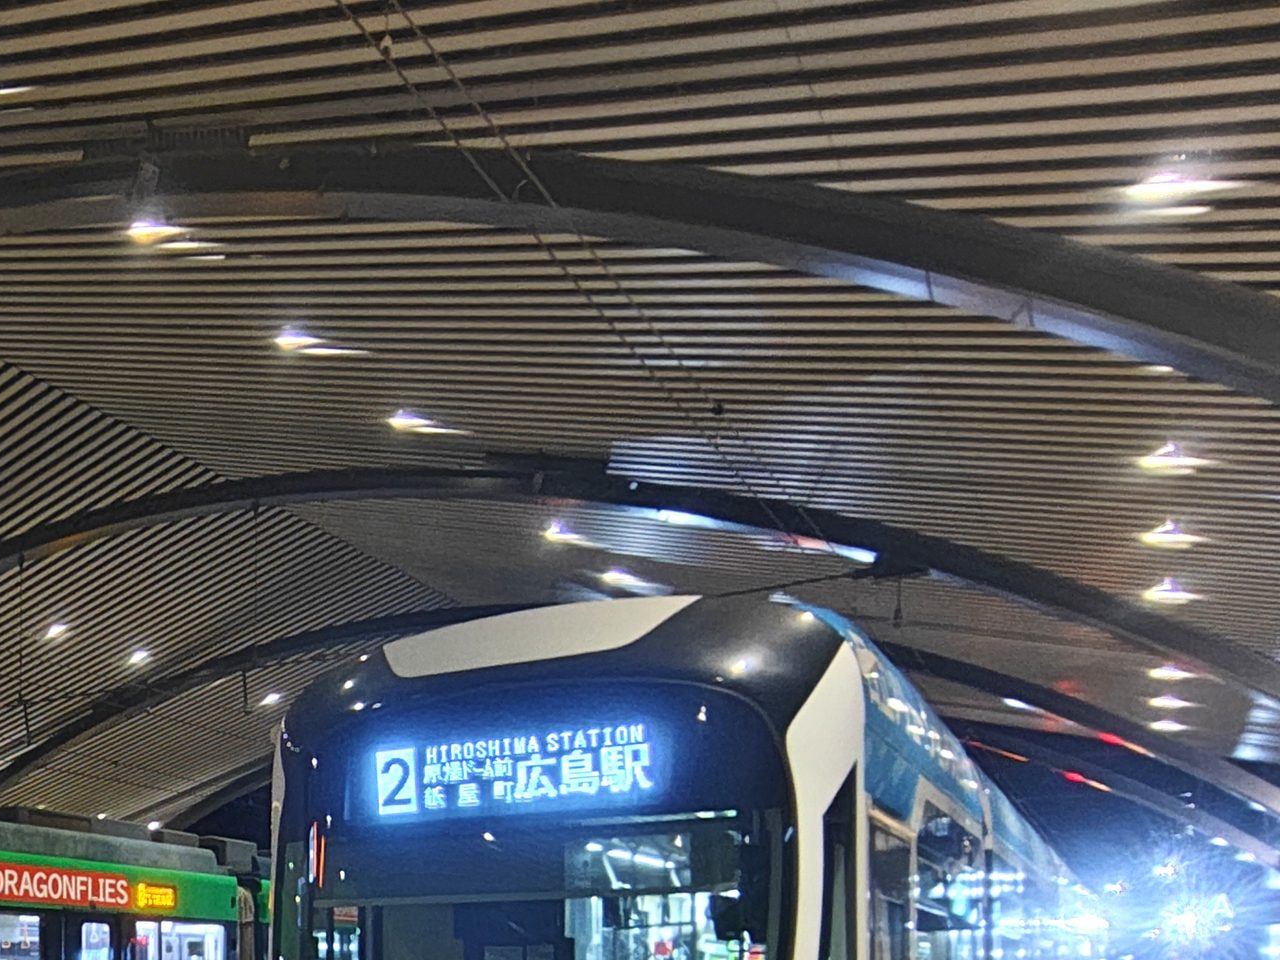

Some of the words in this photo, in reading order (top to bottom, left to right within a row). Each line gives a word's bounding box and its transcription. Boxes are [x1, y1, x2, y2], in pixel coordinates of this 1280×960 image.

[425, 736, 539, 765] HIROSHIMA
[546, 724, 644, 751] STATION
[381, 757, 412, 806] 2
[515, 743, 652, 799] 広島駅
